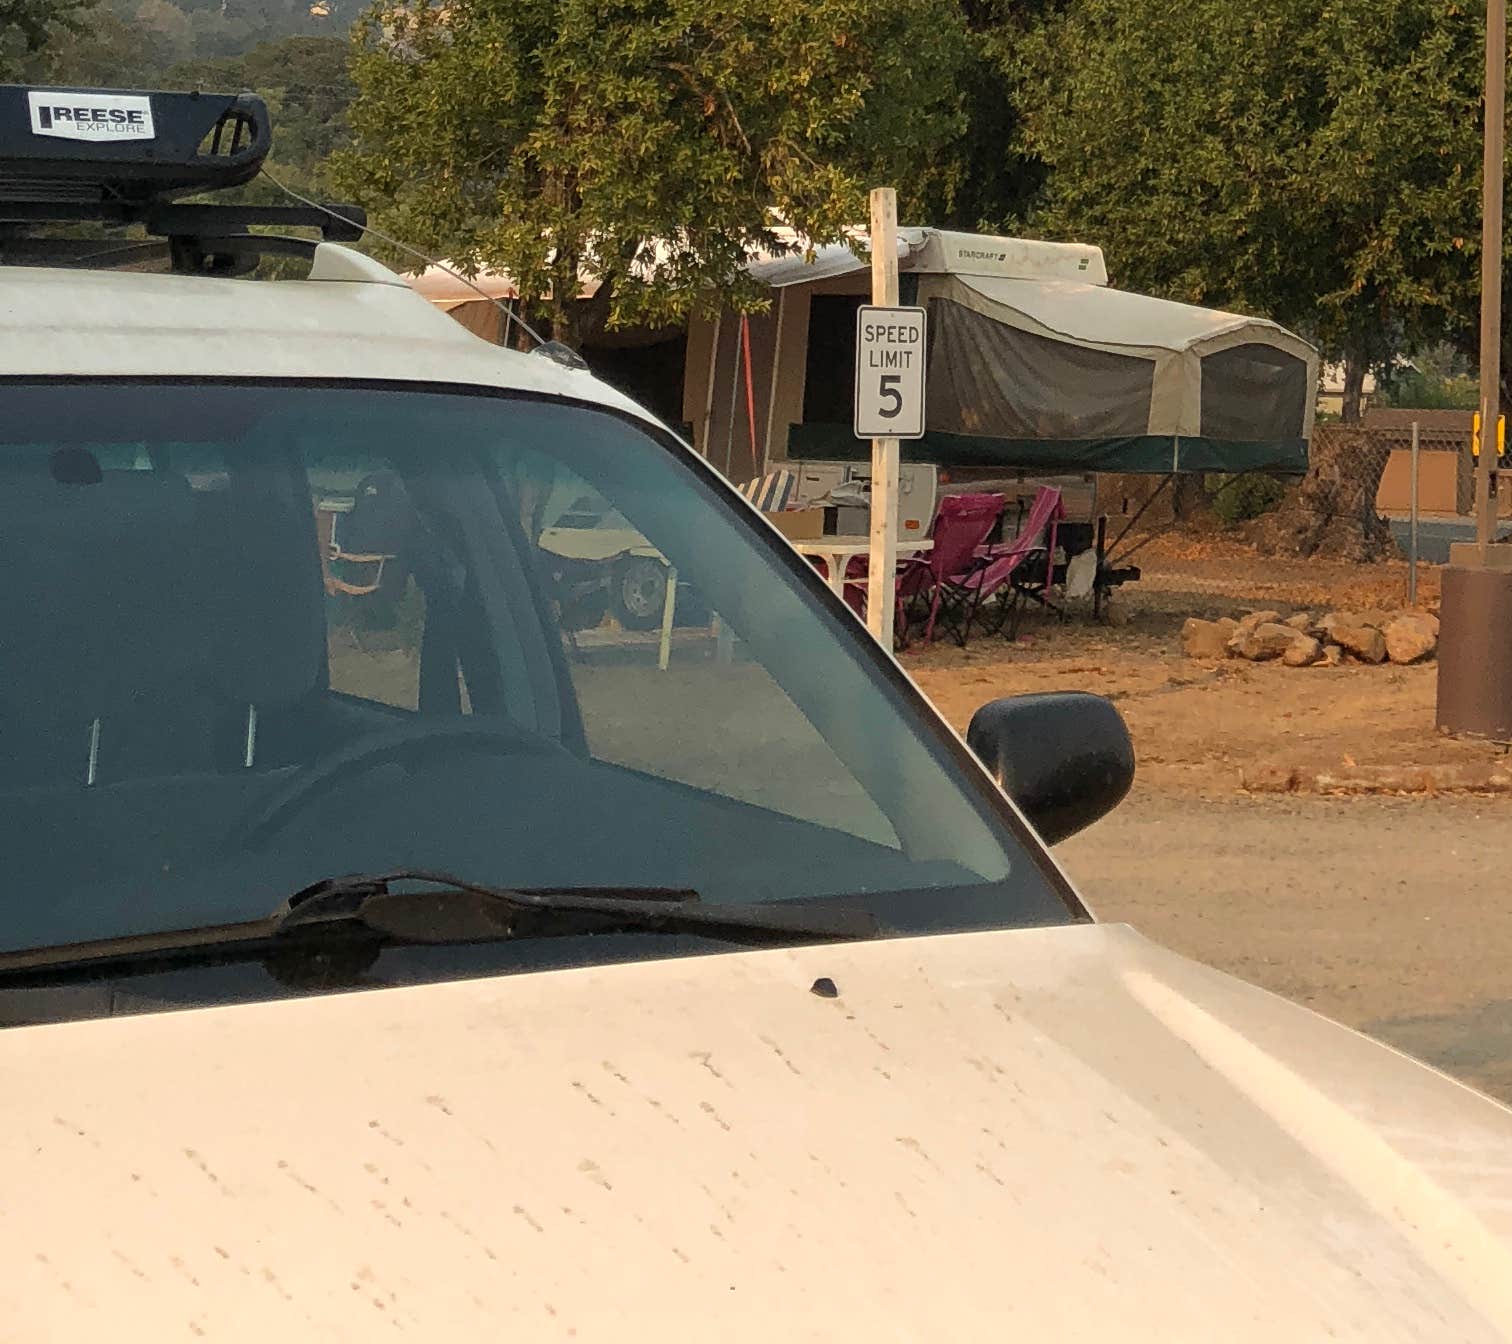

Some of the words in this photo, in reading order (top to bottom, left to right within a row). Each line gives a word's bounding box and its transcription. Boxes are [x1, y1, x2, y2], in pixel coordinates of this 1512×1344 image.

[53, 106, 145, 124] REESE
[76, 122, 145, 133] EXPLORE
[958, 250, 998, 260] STARCRAFT
[864, 324, 919, 344] SPEED
[869, 350, 913, 368] LIMIT
[878, 375, 903, 419] 5
